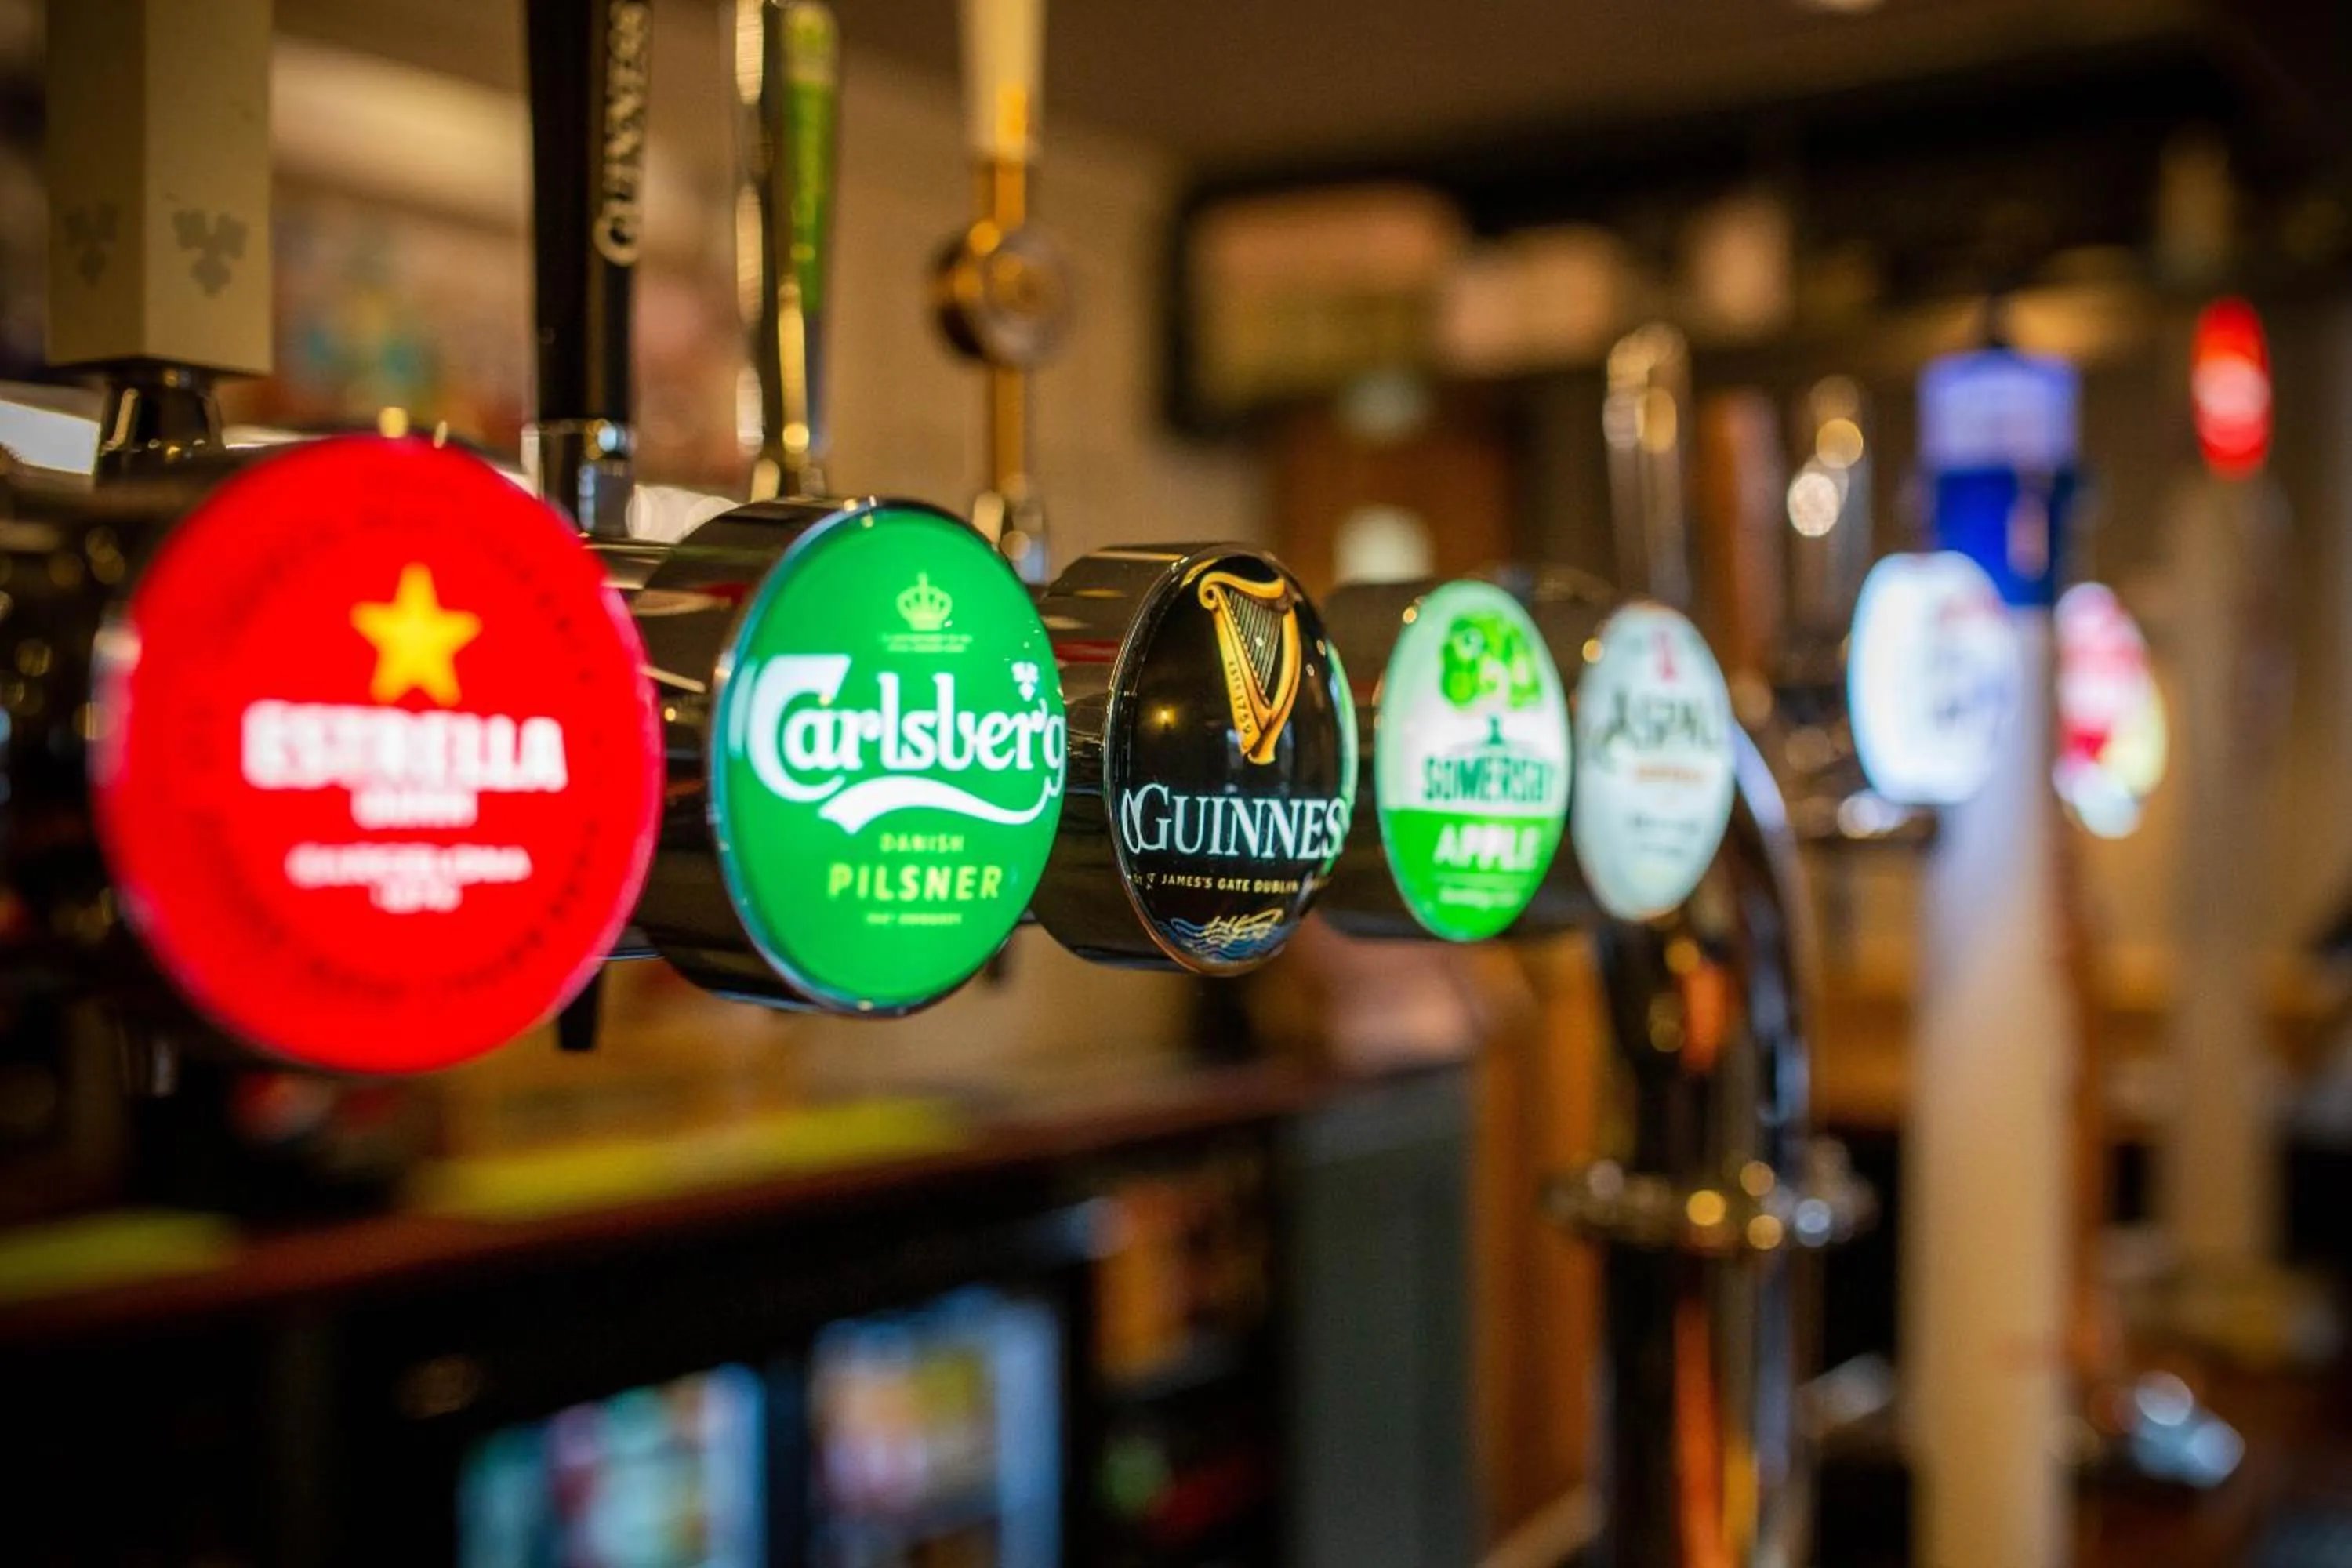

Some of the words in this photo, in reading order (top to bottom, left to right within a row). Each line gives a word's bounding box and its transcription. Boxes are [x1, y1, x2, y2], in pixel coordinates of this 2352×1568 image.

[241, 699, 568, 791] ESTRELLA
[746, 654, 1067, 804] Carlsberg
[1121, 784, 1350, 860] GUINNES
[1433, 822, 1541, 872] APPLE
[829, 862, 1003, 902] PILSNER
[1160, 873, 1213, 889] JAMES'S
[1218, 878, 1250, 892] GATE
[1254, 880, 1299, 895] DUBLIN
